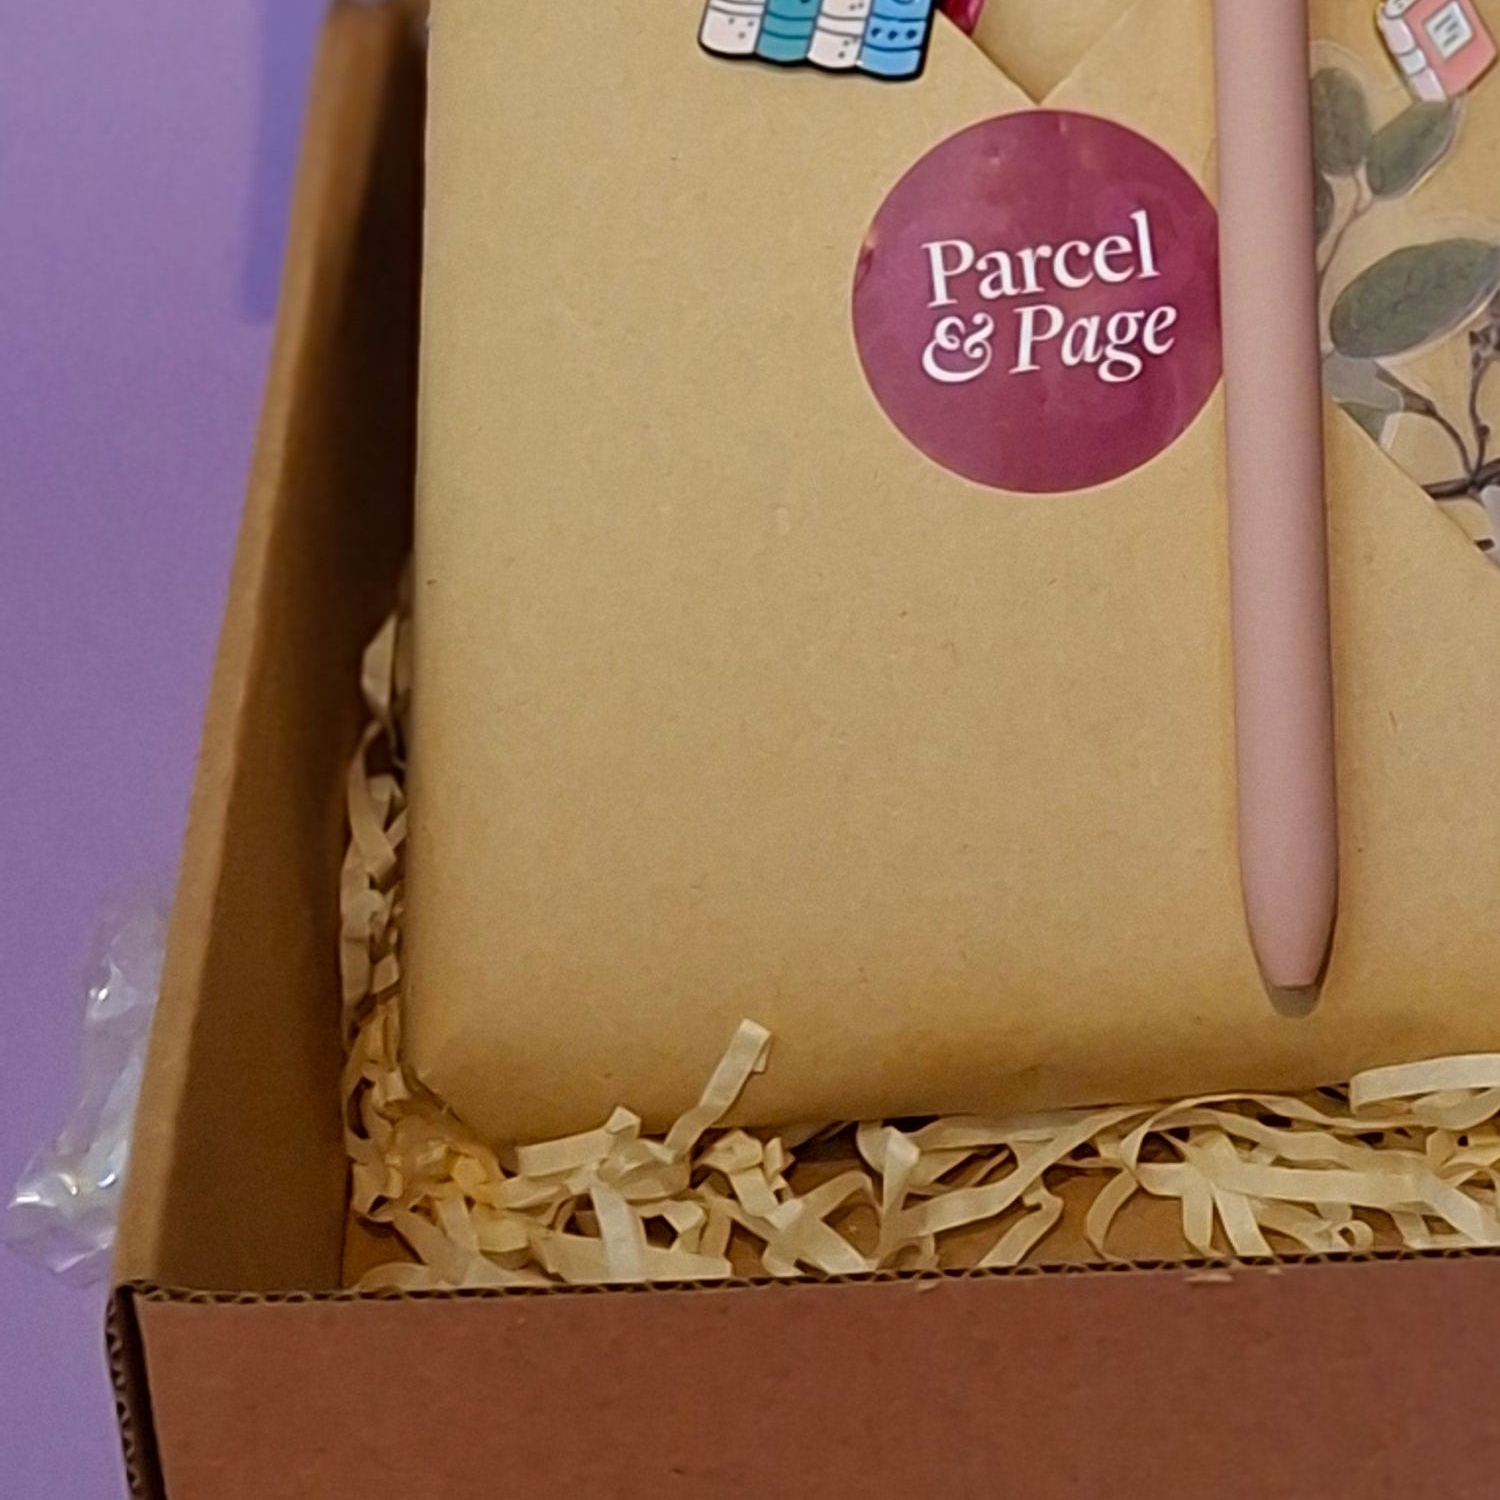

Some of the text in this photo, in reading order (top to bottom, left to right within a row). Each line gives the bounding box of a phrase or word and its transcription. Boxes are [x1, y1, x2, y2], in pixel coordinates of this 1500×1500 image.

[920, 208, 1160, 310] Parcel
[921, 302, 1178, 384] & Page
